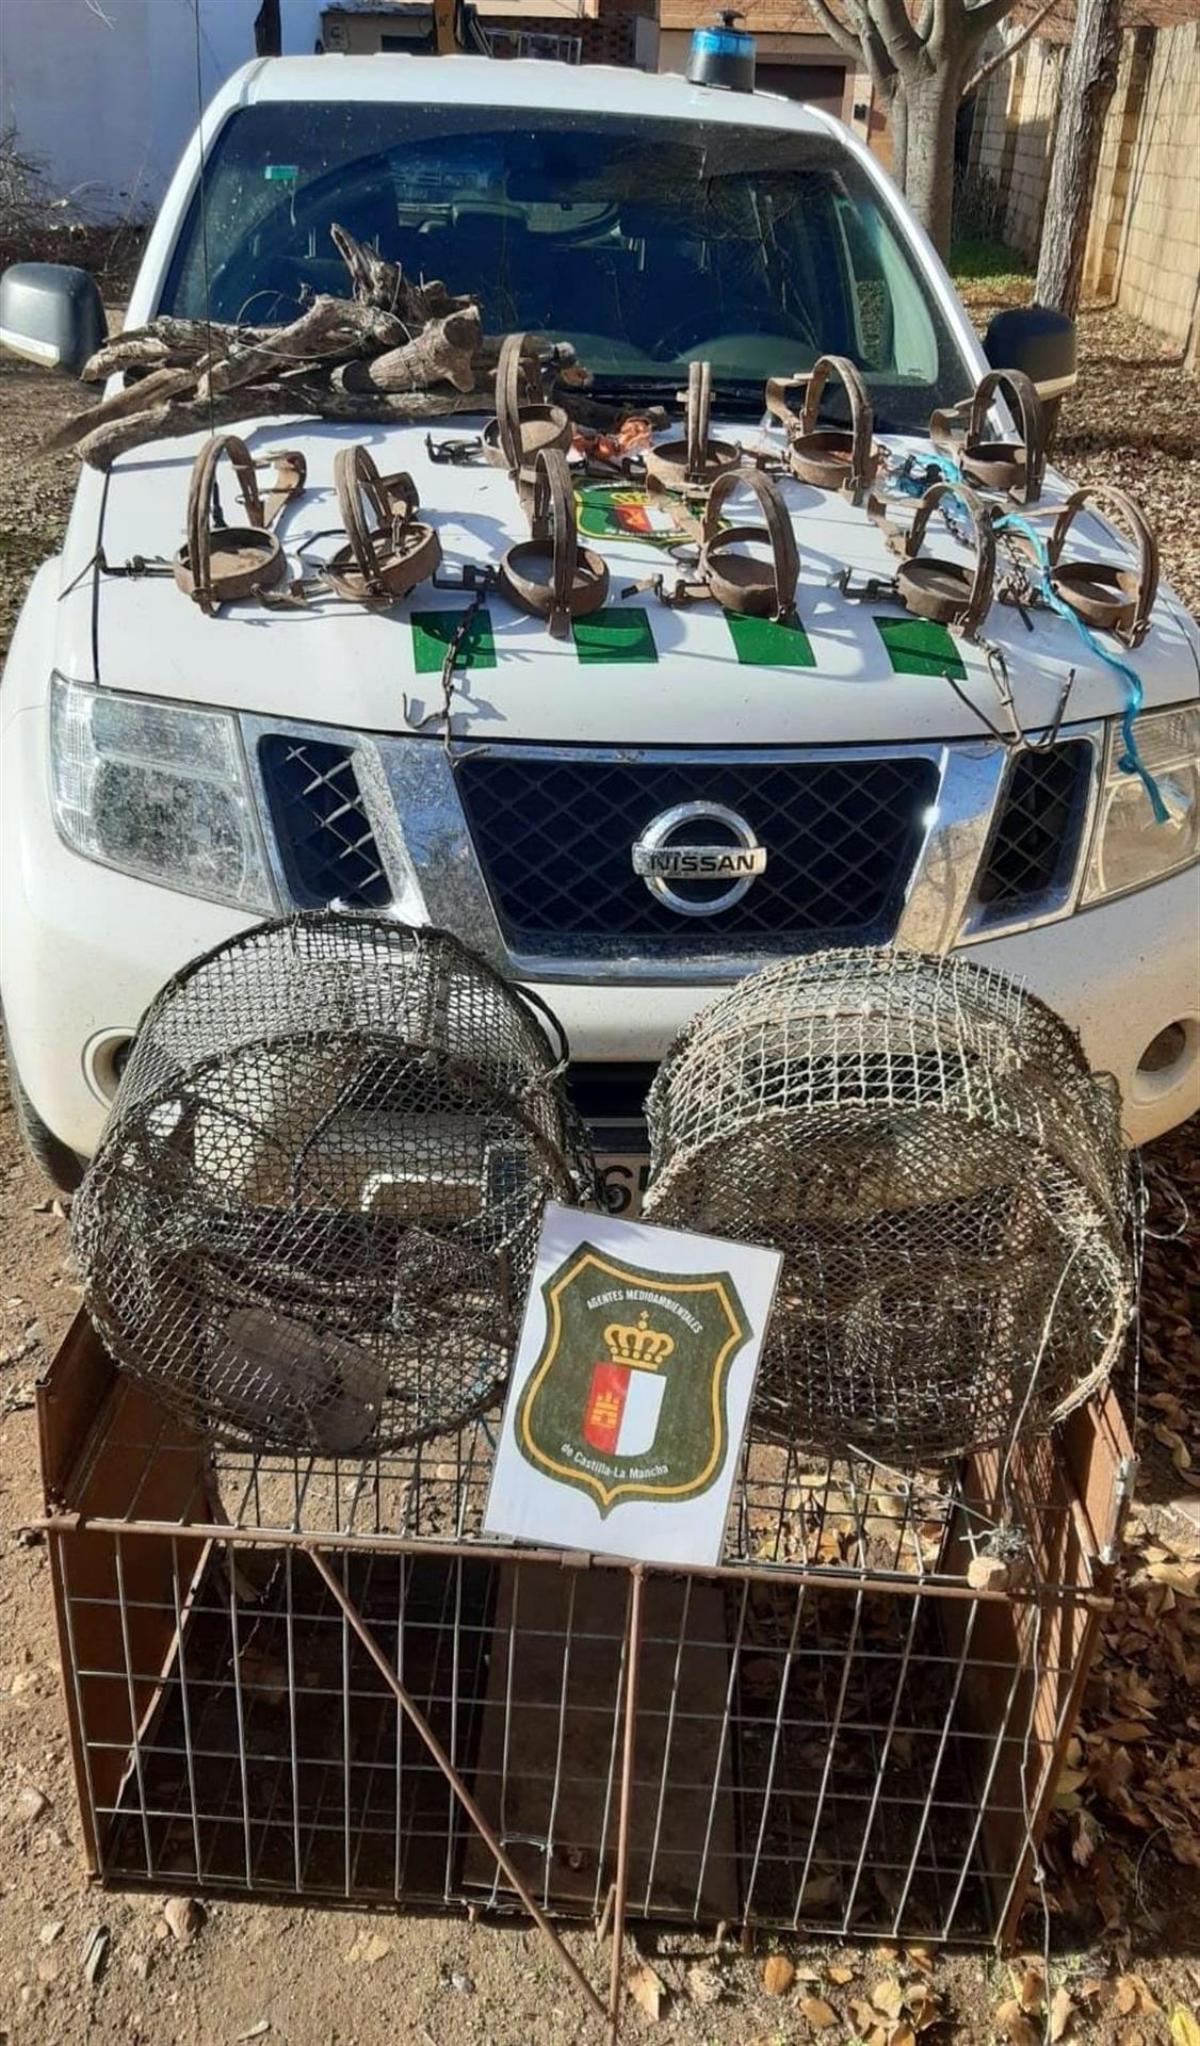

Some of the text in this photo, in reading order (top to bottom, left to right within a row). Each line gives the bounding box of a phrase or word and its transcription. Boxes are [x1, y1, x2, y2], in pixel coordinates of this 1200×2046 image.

[650, 854, 756, 872] NISSAN
[586, 1289, 704, 1334] AGENTES MEDIOAMBIENTALES
[560, 1443, 574, 1457] de
[629, 1463, 669, 1480] Mancha
